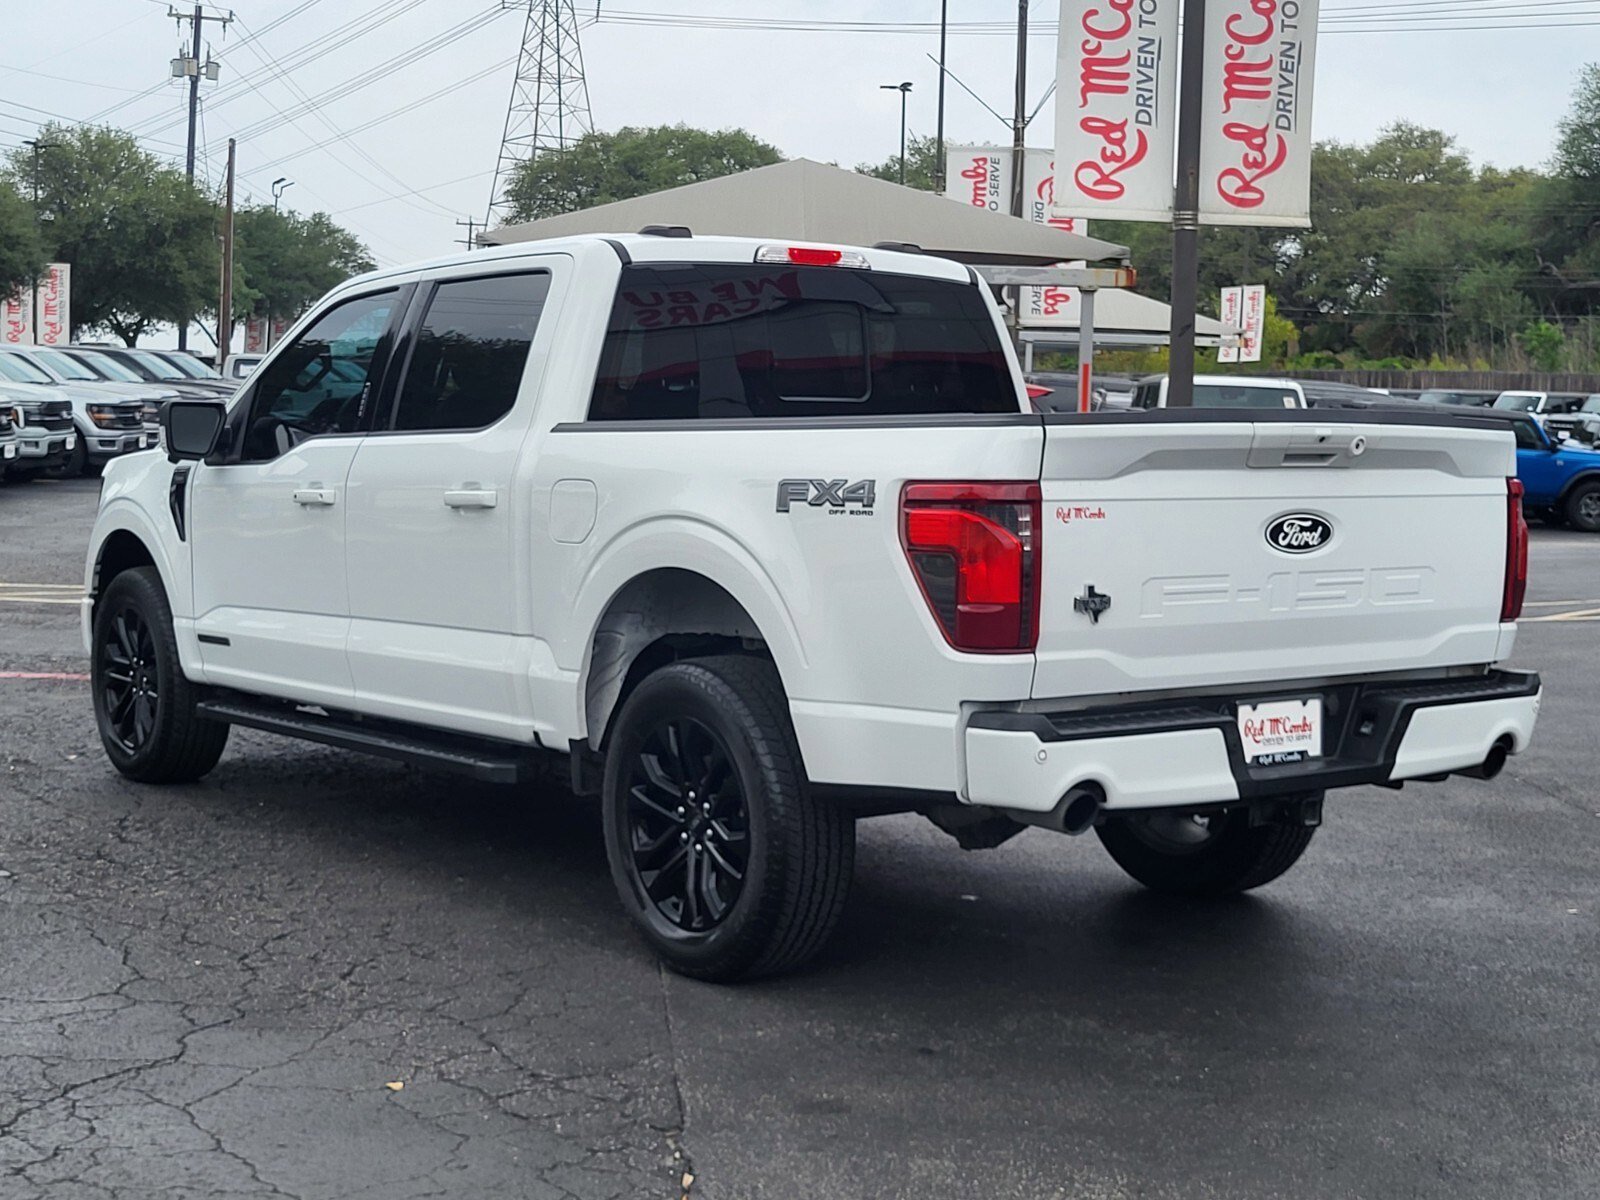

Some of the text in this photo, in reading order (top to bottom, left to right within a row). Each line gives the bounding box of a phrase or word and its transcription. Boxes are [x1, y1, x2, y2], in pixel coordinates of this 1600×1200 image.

[1135, 0, 1157, 126] DRIVEN TO
[1275, 0, 1299, 131] DRIVEN TO
[961, 156, 988, 208] ombs
[988, 156, 1000, 211] O SERVE
[1074, 117, 1148, 200] Red
[1217, 122, 1288, 208] Red
[1034, 201, 1045, 223] DRI
[1031, 285, 1042, 315] ERVE
[776, 479, 876, 513] FX4
[1056, 507, 1071, 524] Red
[1278, 519, 1322, 547] Ford
[1139, 565, 1436, 619] F-150
[1244, 718, 1264, 744] Red
